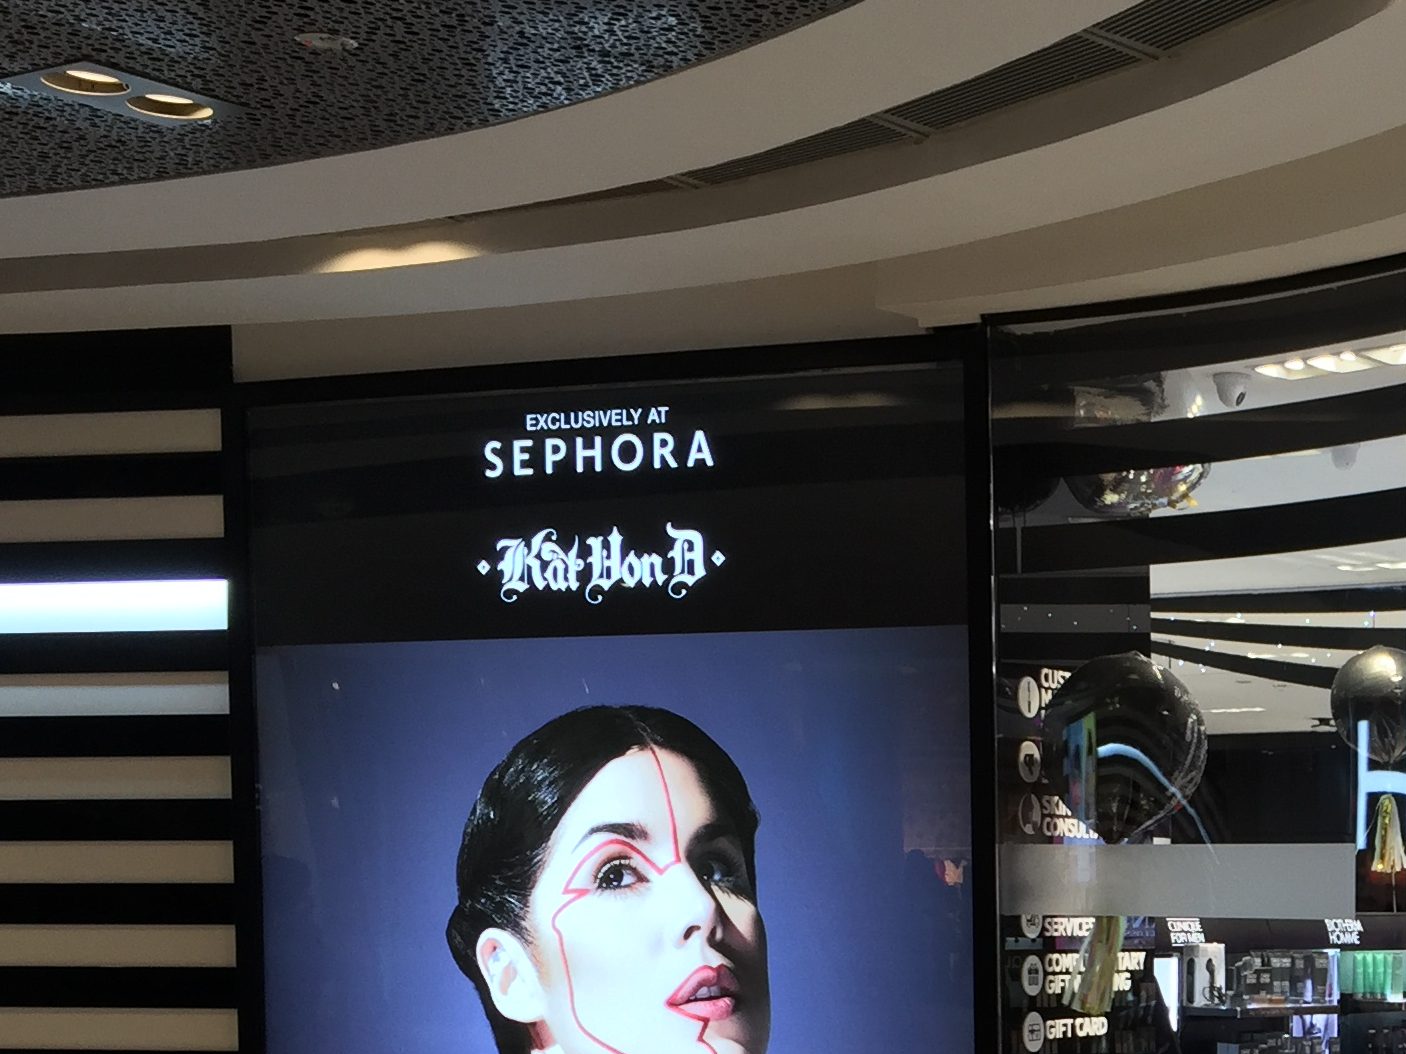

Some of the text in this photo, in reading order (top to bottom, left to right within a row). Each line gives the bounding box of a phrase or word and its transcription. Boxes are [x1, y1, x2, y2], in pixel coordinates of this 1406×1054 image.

[525, 406, 670, 431] EXCLUSIVELY AT
[484, 429, 714, 478] SEPHORA
[496, 521, 707, 604] Kat Von D
[1045, 1016, 1109, 1040] GIFT CARD
